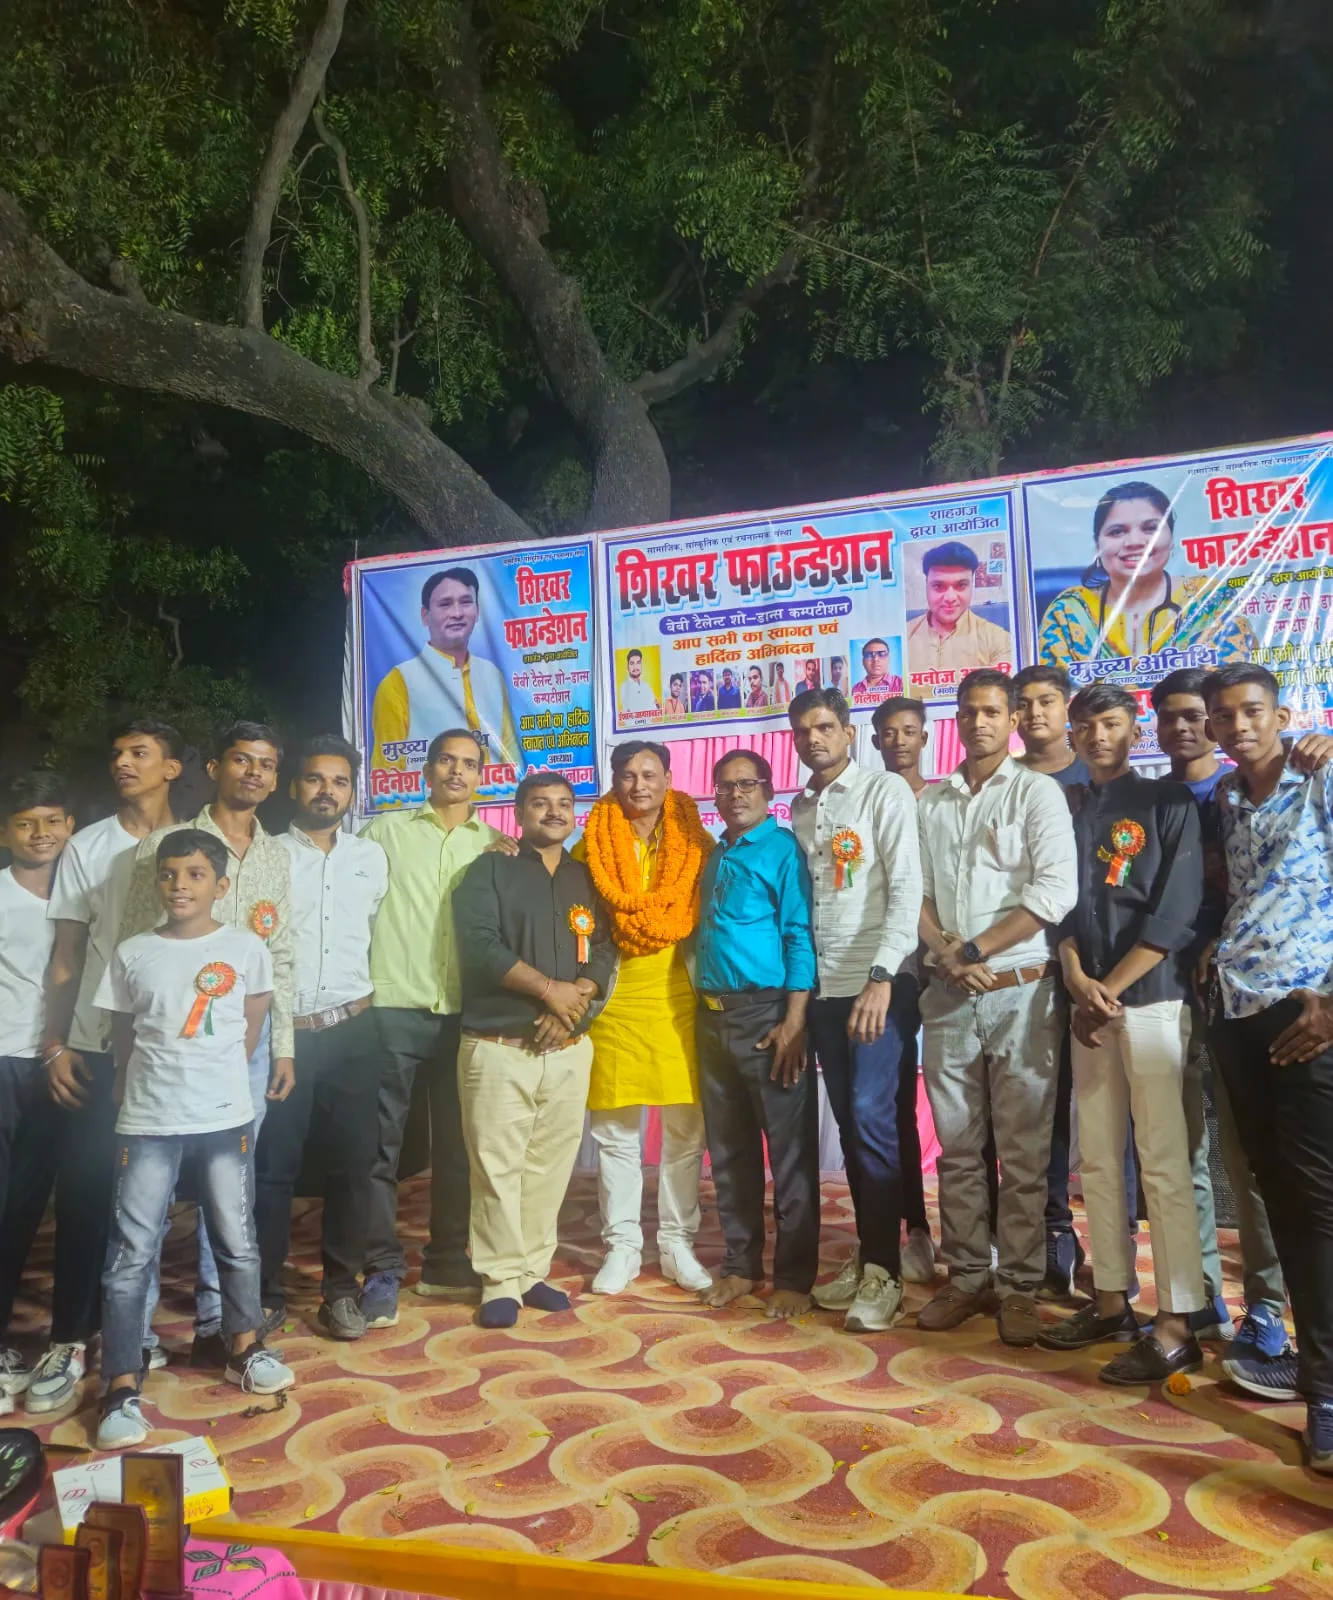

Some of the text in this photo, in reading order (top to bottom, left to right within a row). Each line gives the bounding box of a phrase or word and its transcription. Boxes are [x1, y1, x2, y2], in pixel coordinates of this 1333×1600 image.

[1205, 476, 1308, 521] शिखर
[930, 503, 978, 520] शाहगंज
[721, 534, 733, 546] एवं
[909, 516, 1000, 539] द्वारा आयोजित
[615, 525, 895, 611] शिखर फाउन्डेशन
[515, 566, 572, 606] शिखर
[503, 606, 588, 649] फाउन्डेशन
[692, 613, 726, 629] टैलेन्ट
[788, 601, 850, 618] कम्पटीशन
[672, 618, 839, 651] आप सभी का स्वागत एवं
[695, 641, 815, 666] हार्दिक अभिनंदन
[1069, 644, 1218, 684] मुख्य अतिथि
[910, 667, 956, 685] मनोज
[533, 687, 571, 704] कम्पटीशन
[521, 706, 590, 730] आप सभी का हार्दिक
[382, 739, 429, 761] मुख्य
[522, 736, 544, 751] स्वागत
[370, 767, 422, 796] दिनेश
